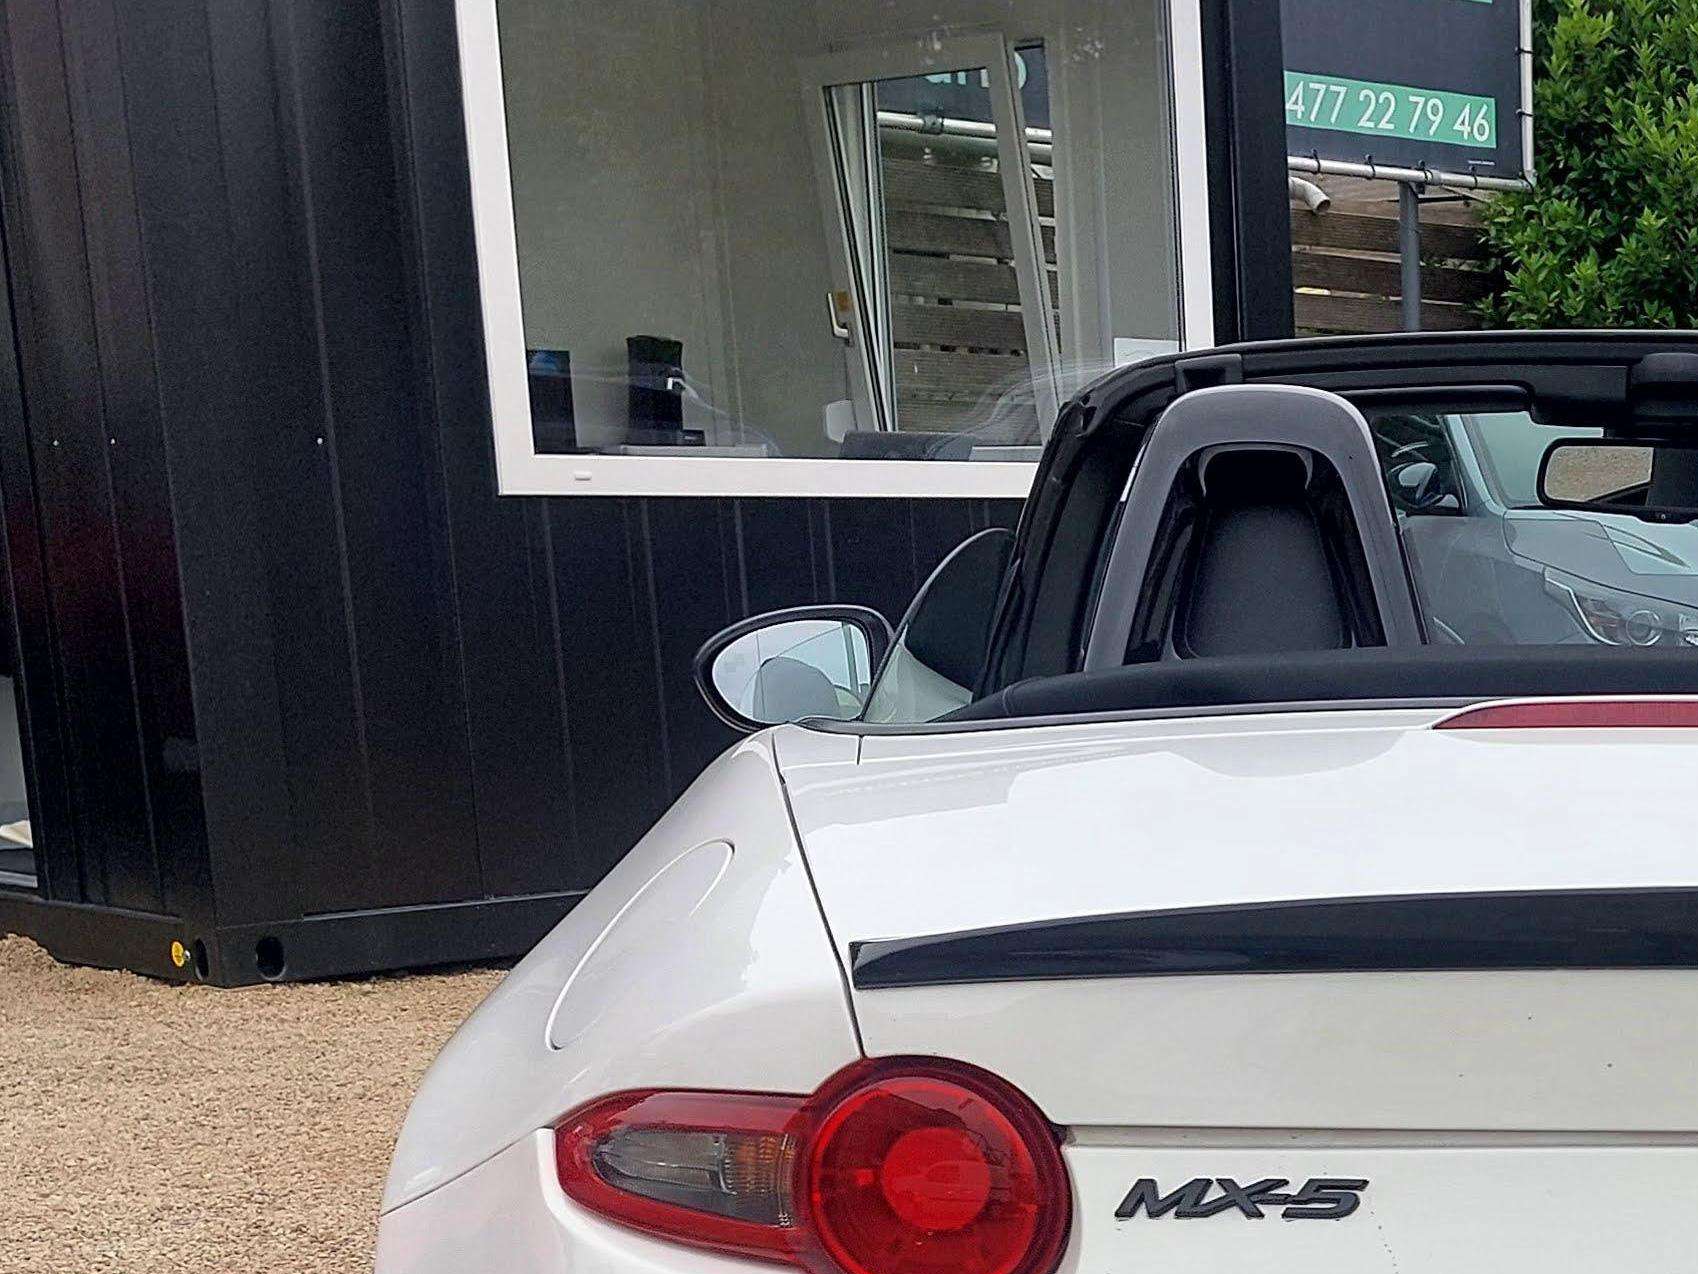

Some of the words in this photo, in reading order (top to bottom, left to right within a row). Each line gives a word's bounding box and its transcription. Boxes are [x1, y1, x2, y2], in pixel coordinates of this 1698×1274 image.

[1285, 80, 1348, 125] 477
[1357, 88, 1397, 131] 22
[1408, 95, 1444, 137] 79
[1453, 102, 1490, 143] 46
[1113, 1177, 1370, 1220] MX-5
